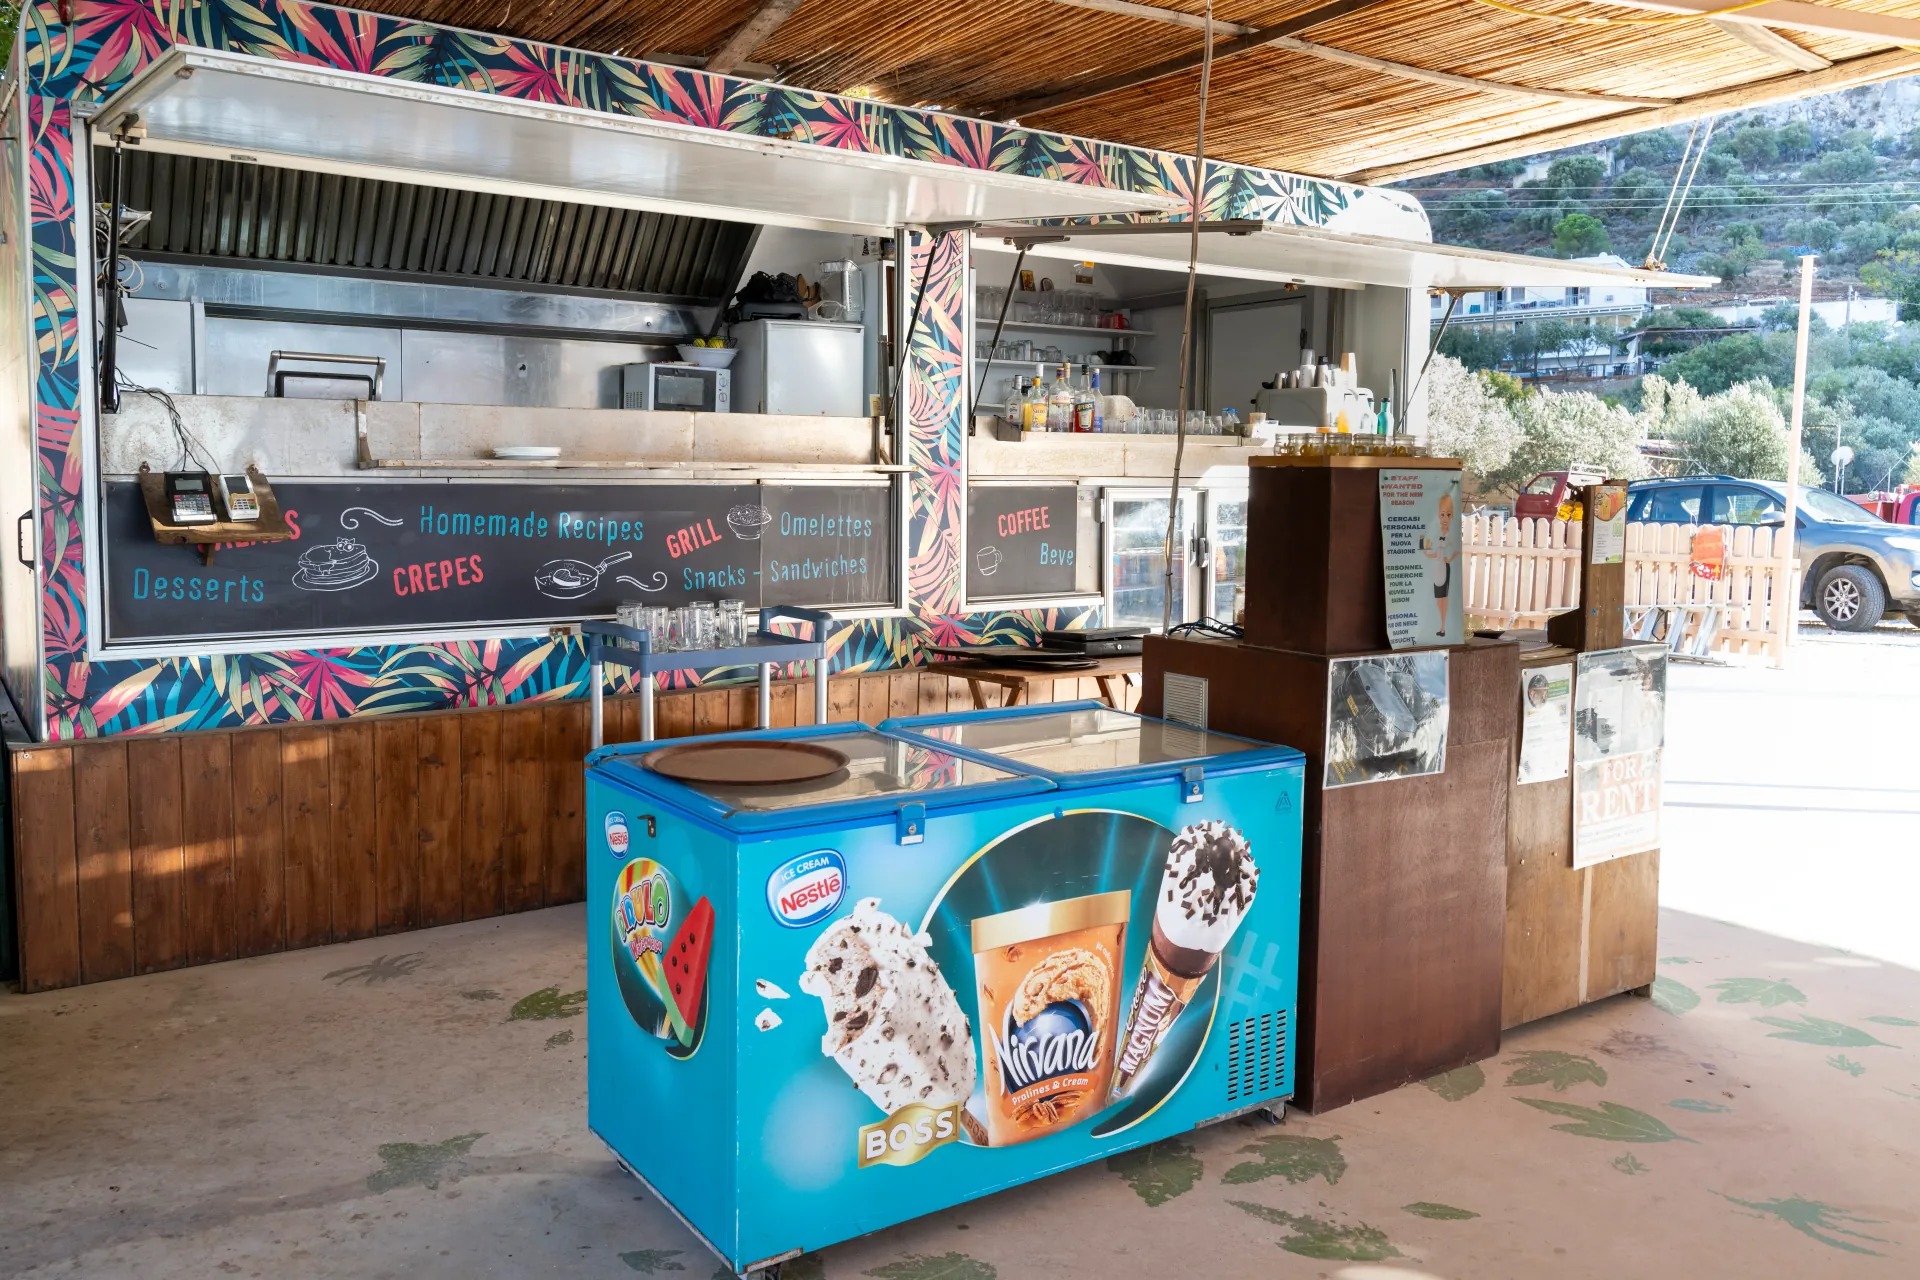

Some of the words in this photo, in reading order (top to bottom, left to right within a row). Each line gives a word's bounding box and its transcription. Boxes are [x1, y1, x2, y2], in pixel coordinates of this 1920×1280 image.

[420, 506, 548, 538] Homemade
[558, 511, 644, 546] Recipes
[666, 518, 722, 558] GRILL
[780, 511, 872, 538] Omelettes
[998, 506, 1050, 537] COFFEE
[683, 564, 746, 591] Snacks
[771, 555, 867, 583] Sandwiches
[1040, 542, 1074, 566] Beve
[134, 568, 264, 603] Desserts
[393, 554, 484, 596] CREPES
[1581, 780, 1656, 825] RENT
[781, 868, 796, 882] ICE
[796, 856, 830, 874] CREAM
[781, 873, 840, 914] Nestlé
[1119, 976, 1174, 1076] MAGNUM
[988, 1018, 1101, 1097] Nirvana
[1011, 1084, 1050, 1106] Pralines
[1052, 1080, 1061, 1090] &
[1062, 1078, 1089, 1088] Cream
[866, 1110, 954, 1160] BOSS
